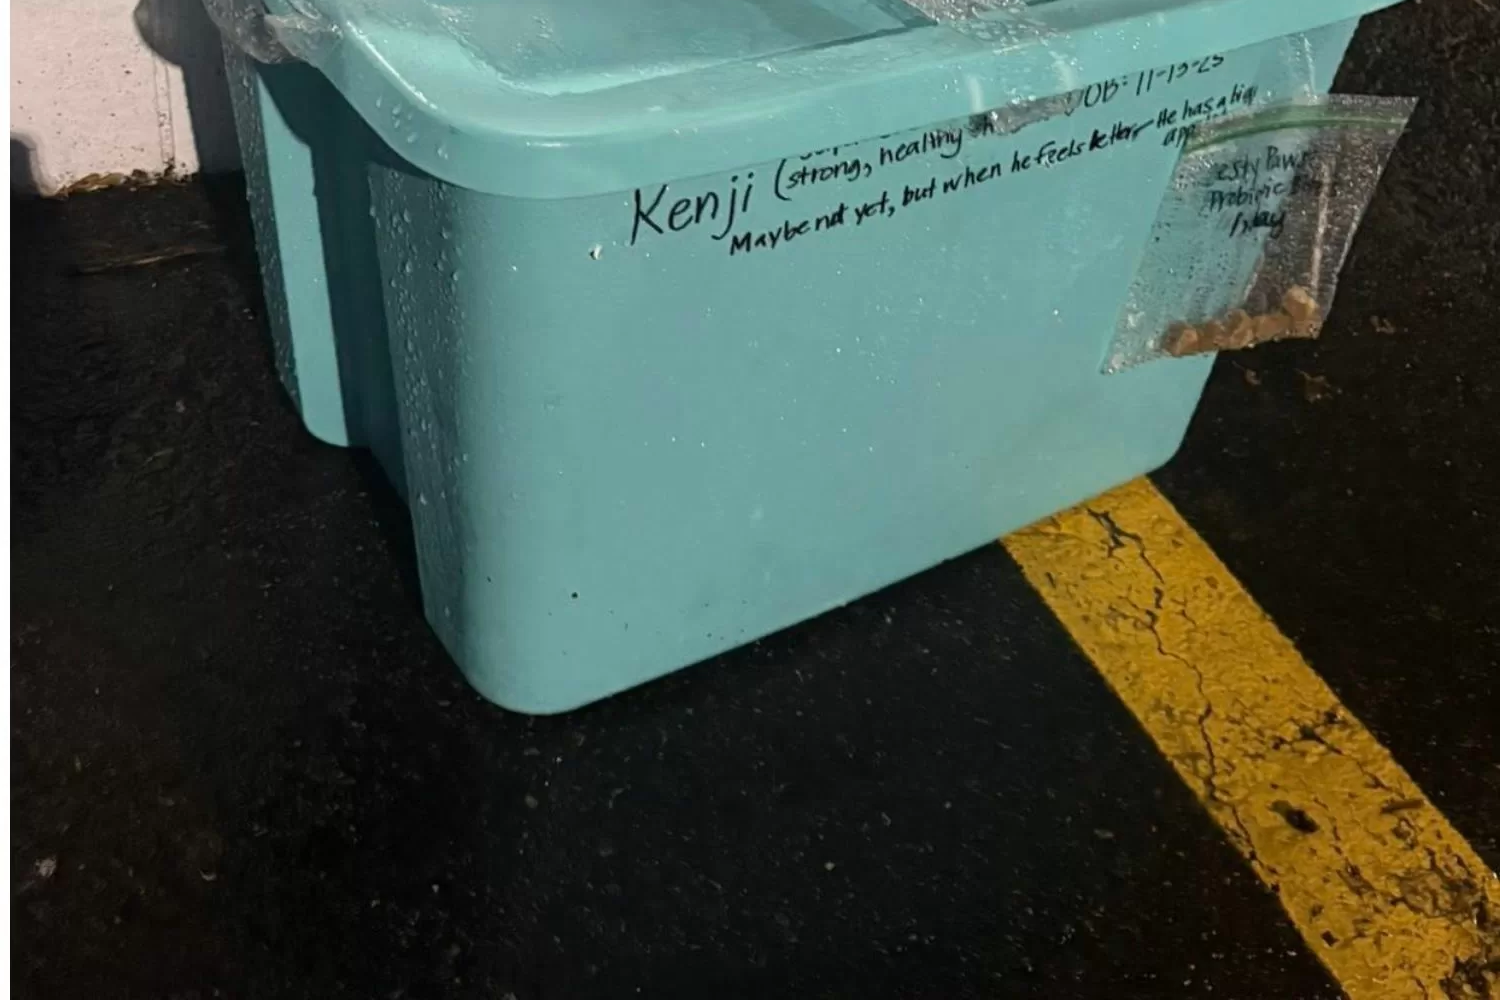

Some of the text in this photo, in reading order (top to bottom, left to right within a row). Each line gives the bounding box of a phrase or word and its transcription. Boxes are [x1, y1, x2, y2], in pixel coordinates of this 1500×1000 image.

[631, 171, 755, 246] Kenji
[774, 158, 873, 201] (strong,
[730, 220, 810, 256] Maybe
[854, 191, 896, 226] yet,
[902, 177, 937, 206] but
[943, 162, 1002, 194] when
[1011, 150, 1031, 173] he
[1034, 139, 1087, 166] feels
[1156, 107, 1177, 128] He
[1182, 96, 1214, 120] has
